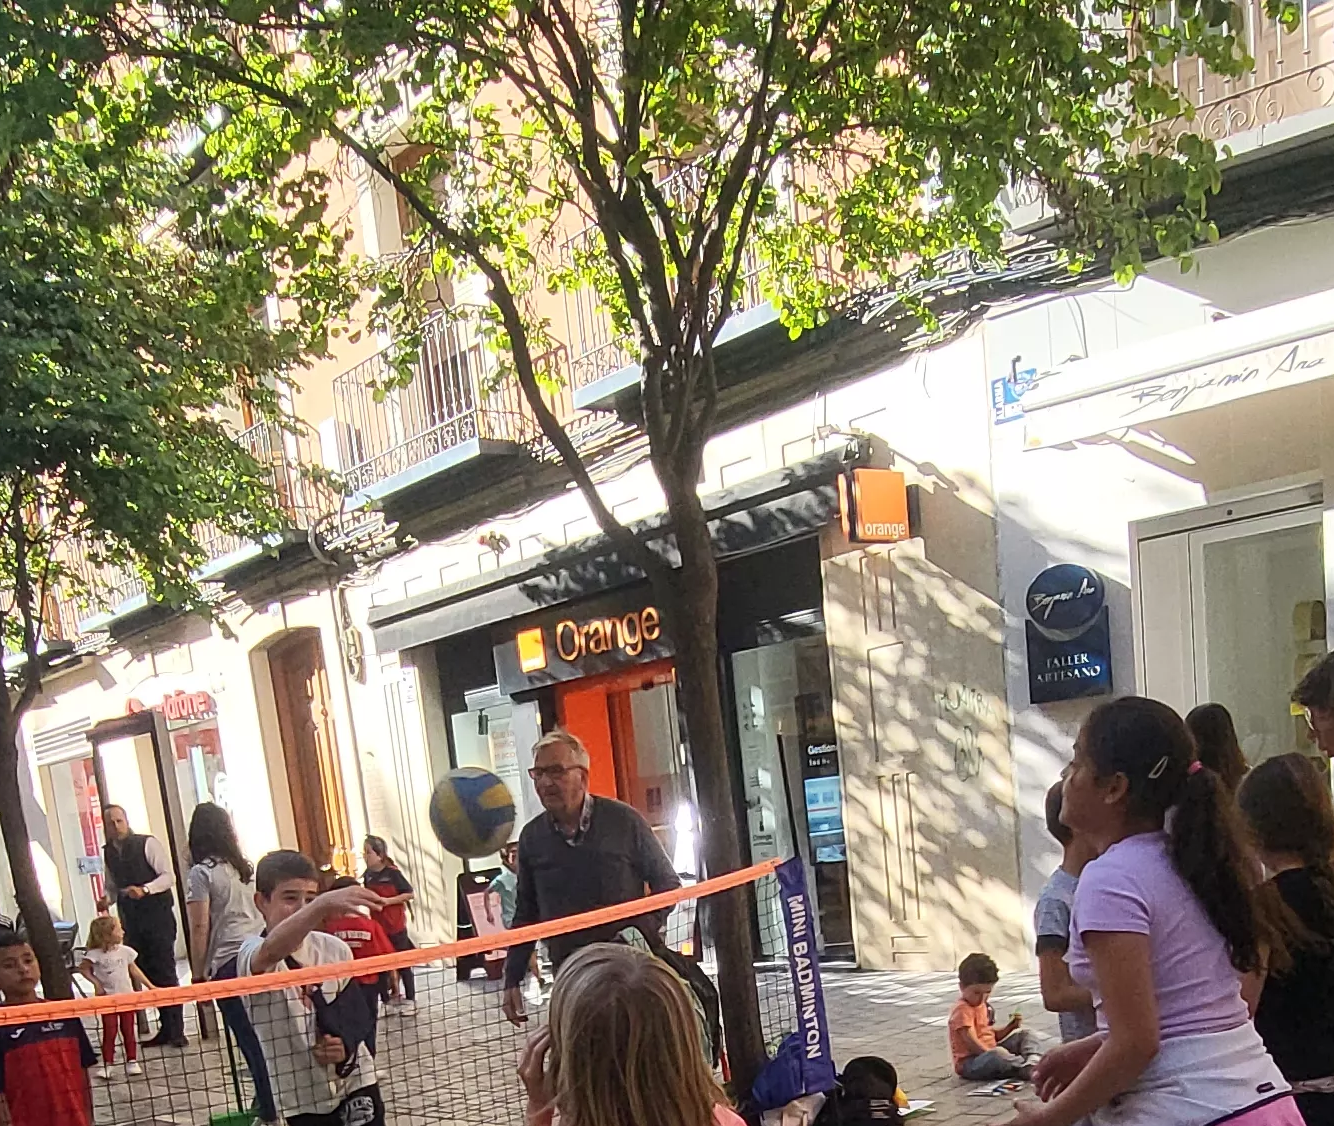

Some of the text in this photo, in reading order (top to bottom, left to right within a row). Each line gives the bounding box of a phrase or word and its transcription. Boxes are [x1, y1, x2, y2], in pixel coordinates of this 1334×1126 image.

[1267, 345, 1325, 381] Ara
[864, 522, 906, 539] orange
[555, 606, 661, 661] Orange
[1035, 665, 1102, 683] ARTESANO
[1044, 652, 1090, 669] TALLER
[152, 690, 211, 720] dafone
[787, 894, 822, 1060] MINI BADMINTON
